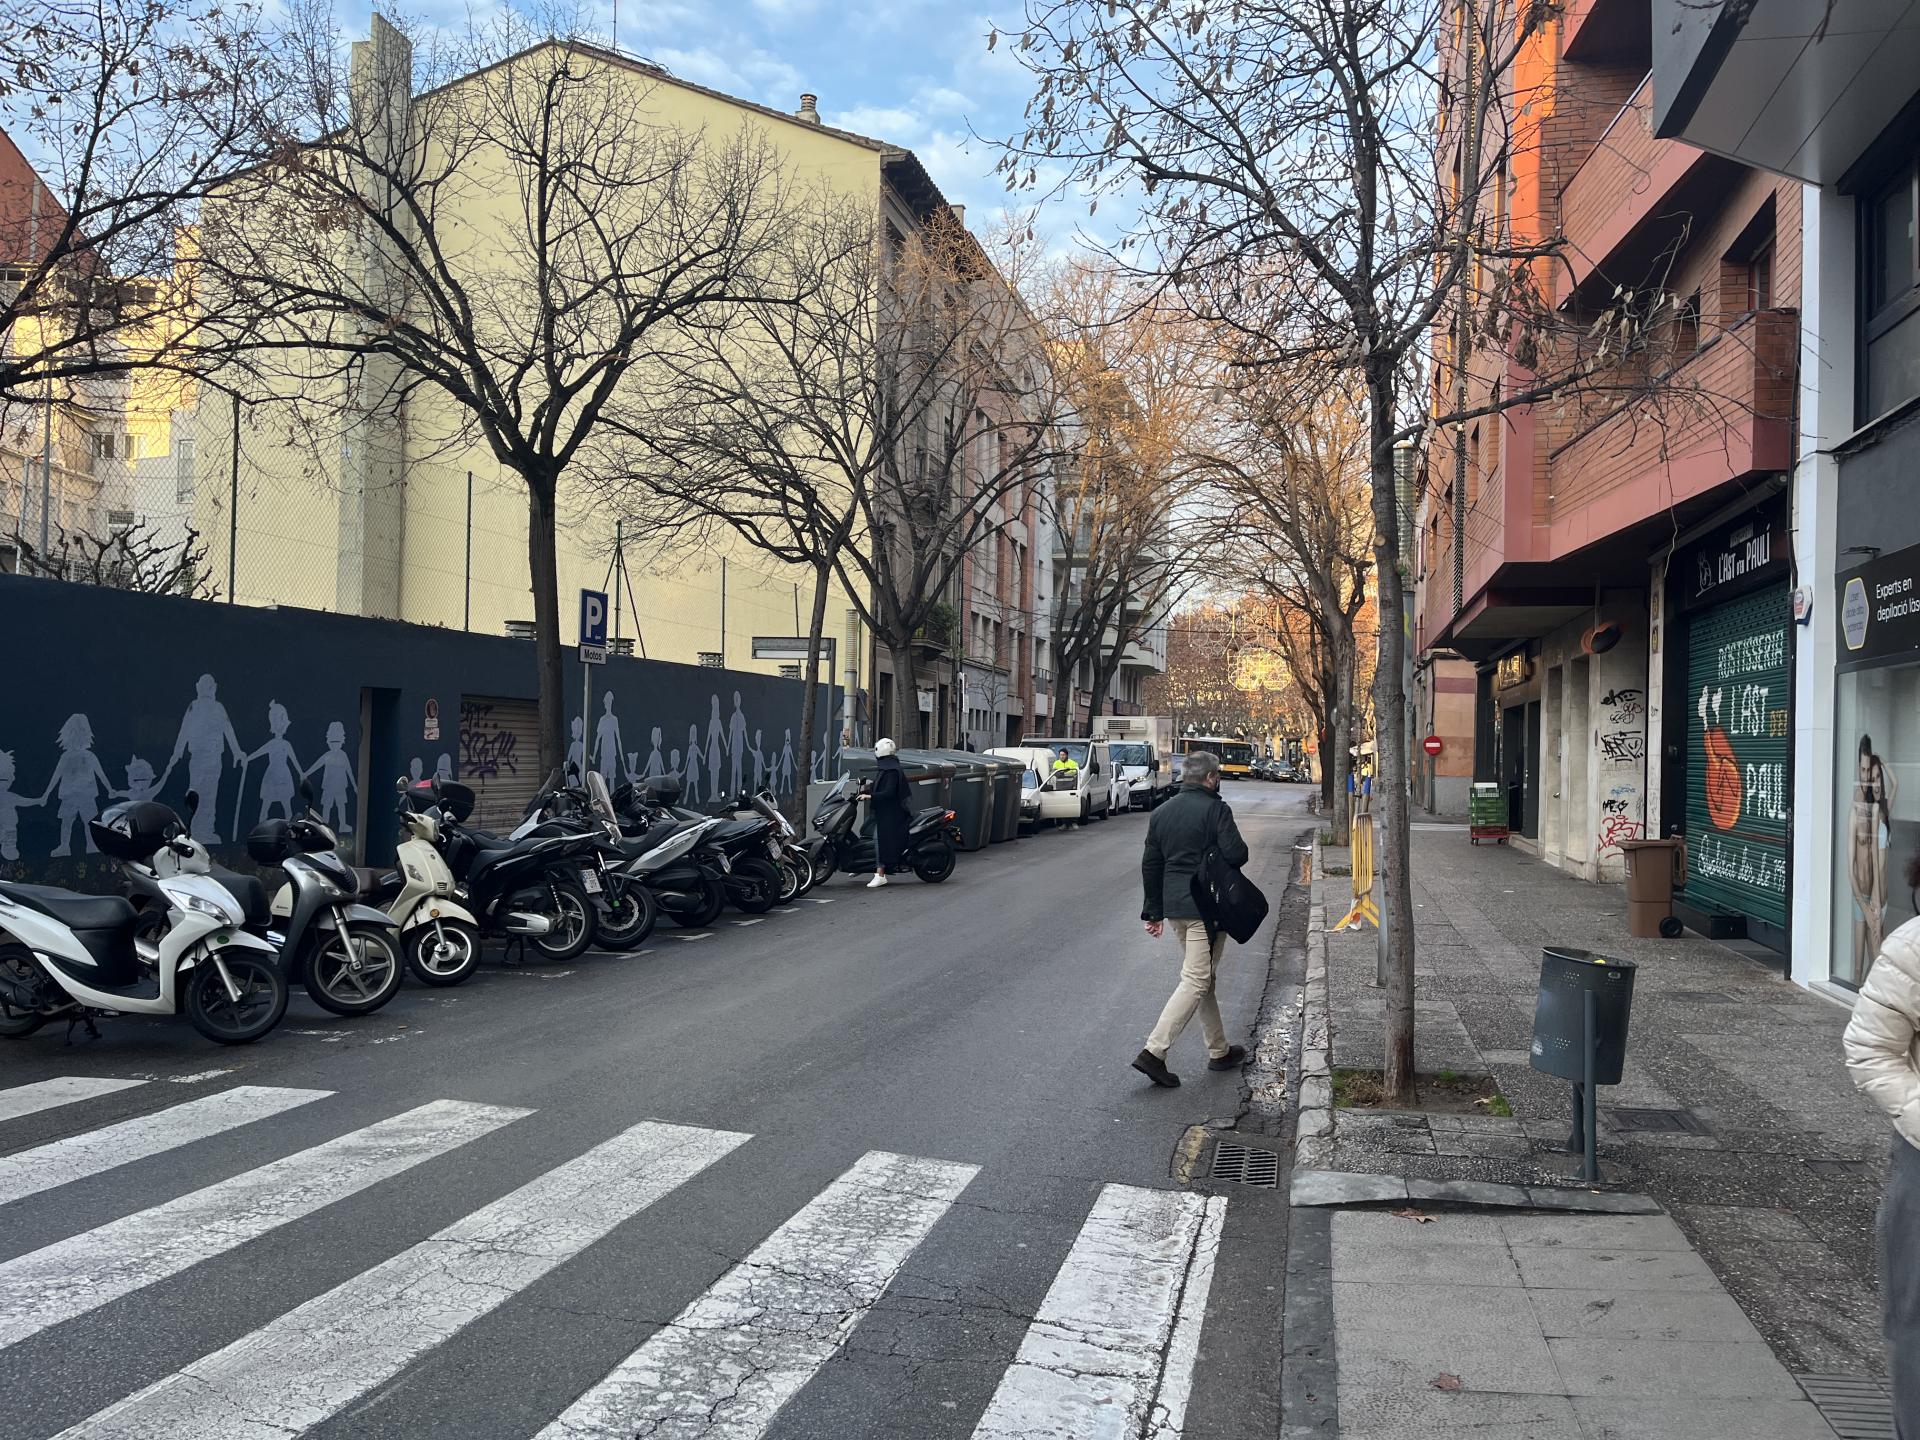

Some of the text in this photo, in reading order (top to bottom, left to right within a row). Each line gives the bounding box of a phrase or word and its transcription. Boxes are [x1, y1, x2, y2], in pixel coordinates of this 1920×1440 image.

[1718, 553, 1737, 585] L'AST
[1745, 522, 1771, 573] PAULÍ
[1876, 577, 1913, 600] Experts en
[1876, 597, 1920, 623] depilació làs
[585, 596, 603, 638] P
[584, 648, 602, 661] Motos
[1718, 629, 1784, 680] ROSTISSERIA
[1730, 683, 1769, 737] L'AST
[1746, 762, 1787, 819] PAUL
